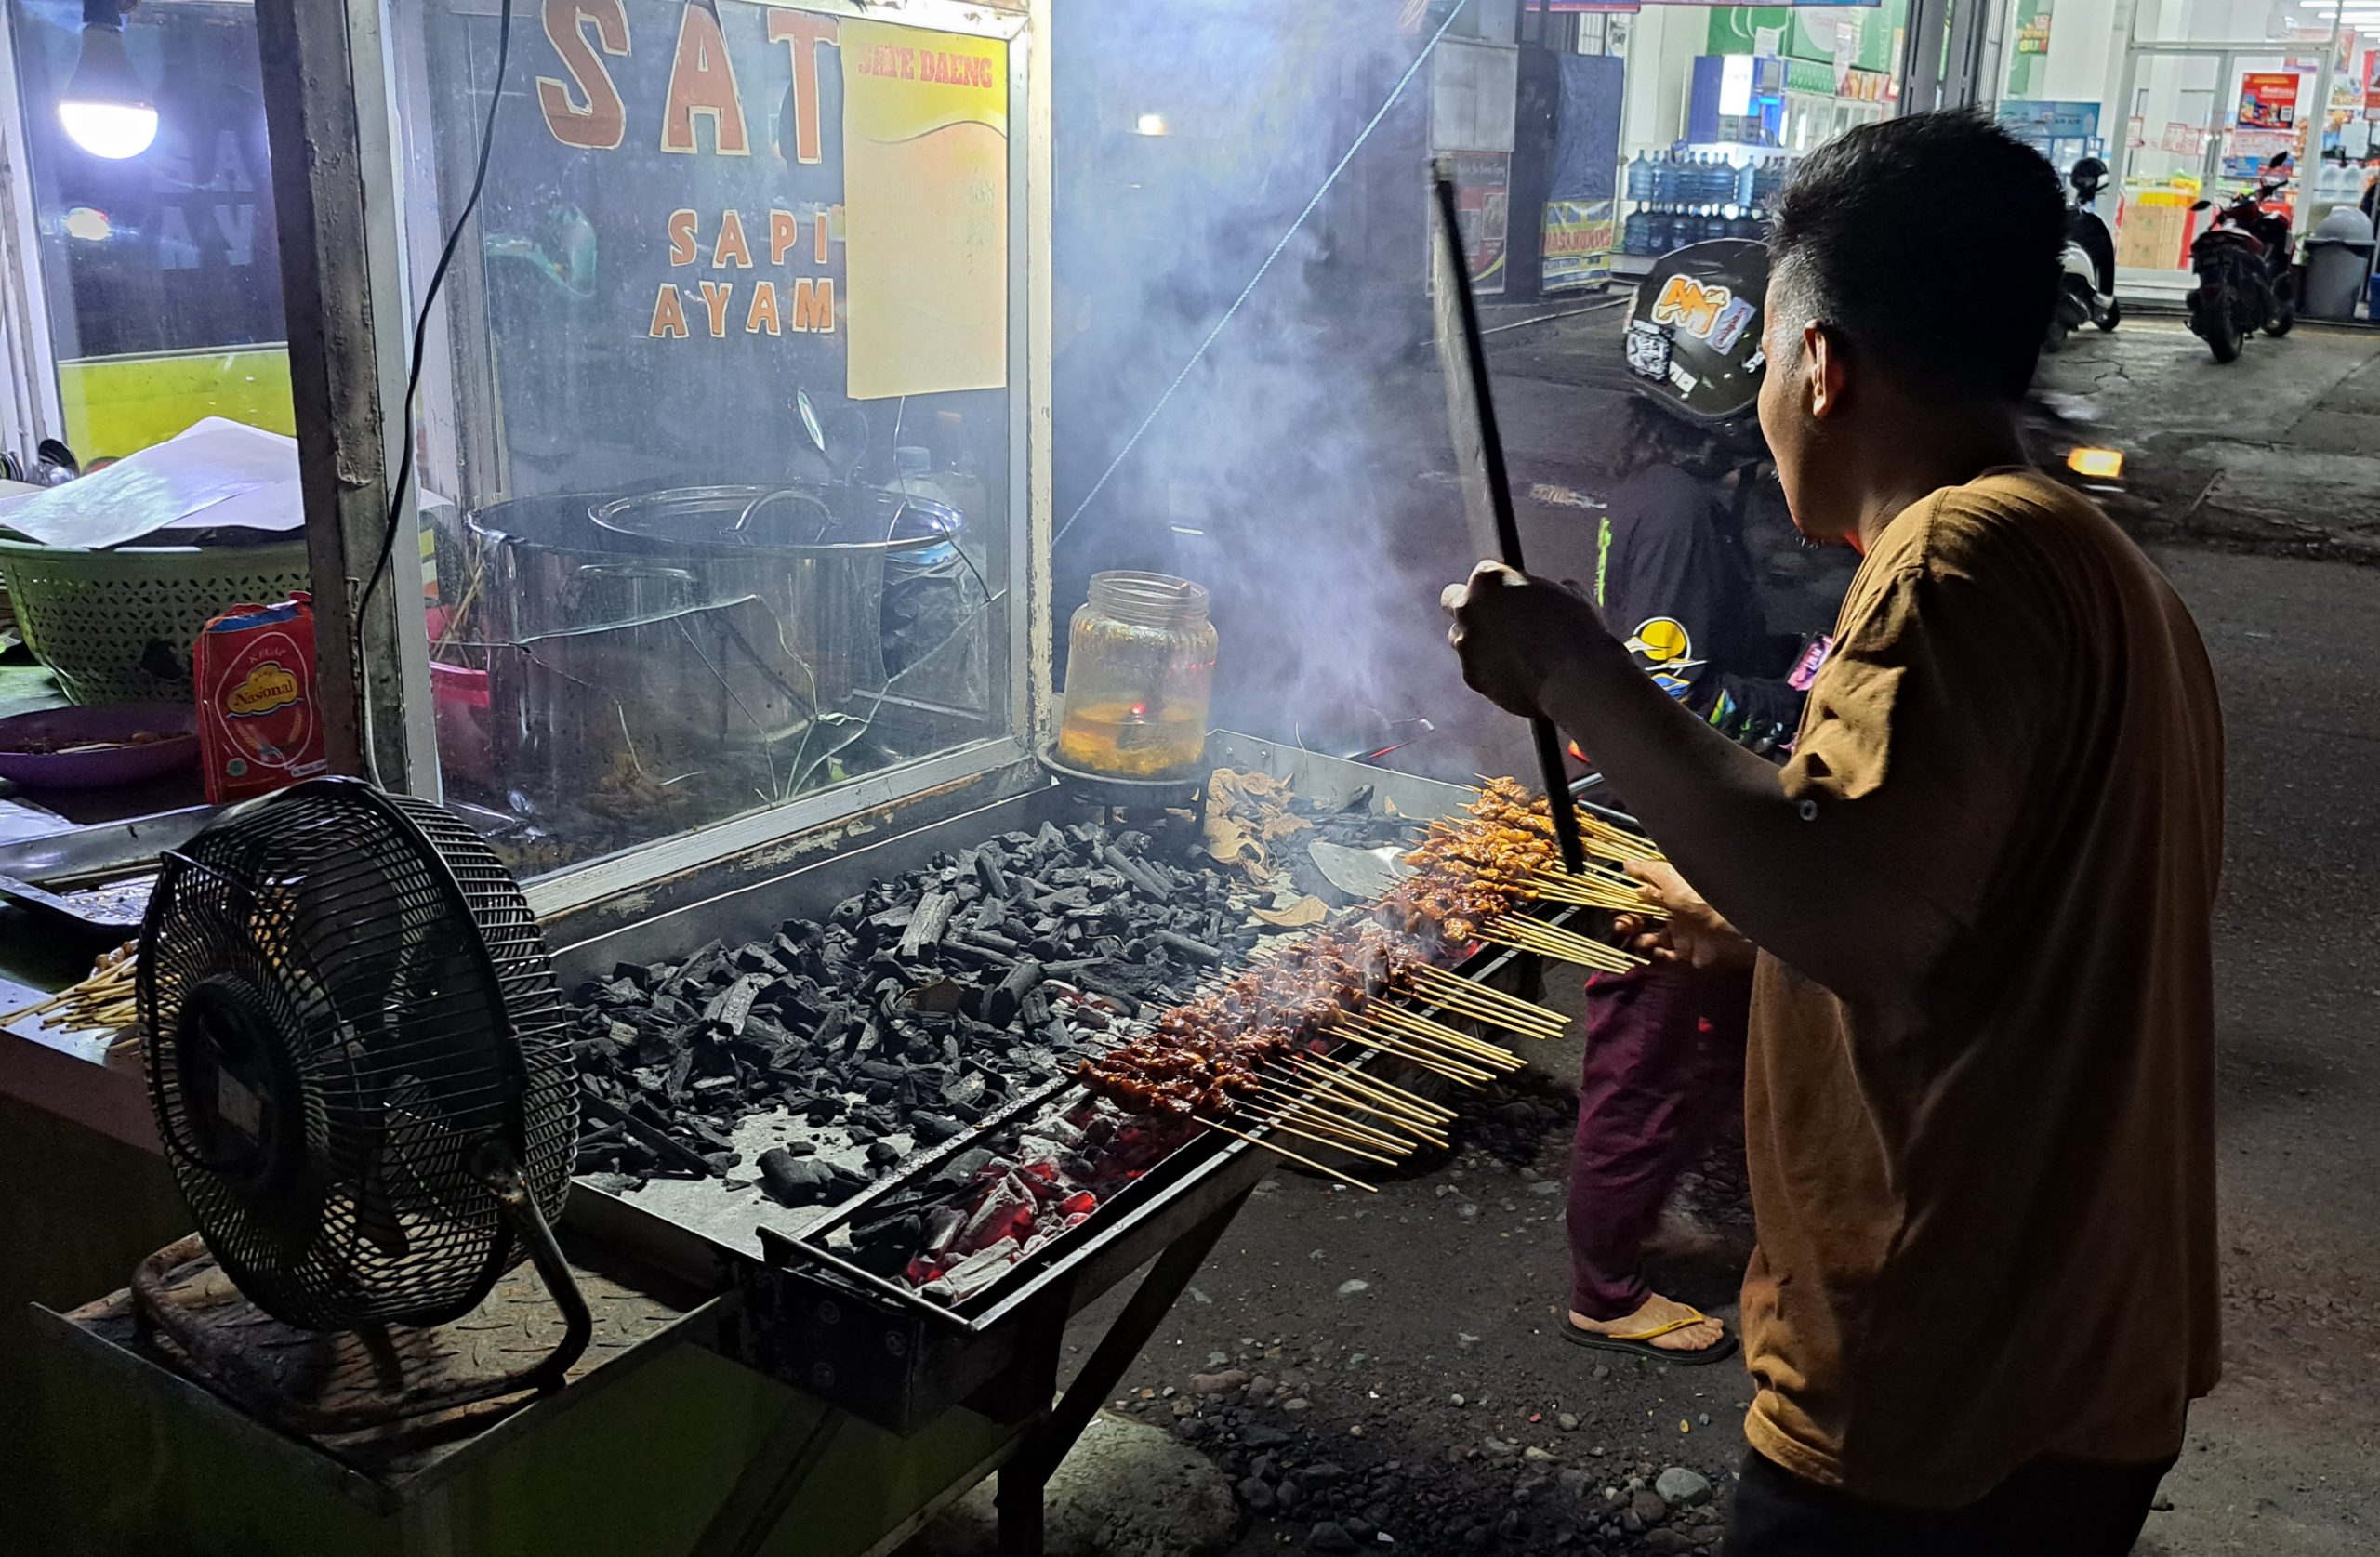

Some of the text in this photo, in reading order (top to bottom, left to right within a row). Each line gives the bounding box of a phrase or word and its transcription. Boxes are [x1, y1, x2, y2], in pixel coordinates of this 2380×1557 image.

[919, 49, 993, 89] DAENG
[668, 208, 828, 269] SAPI
[649, 278, 834, 338] AYAM
